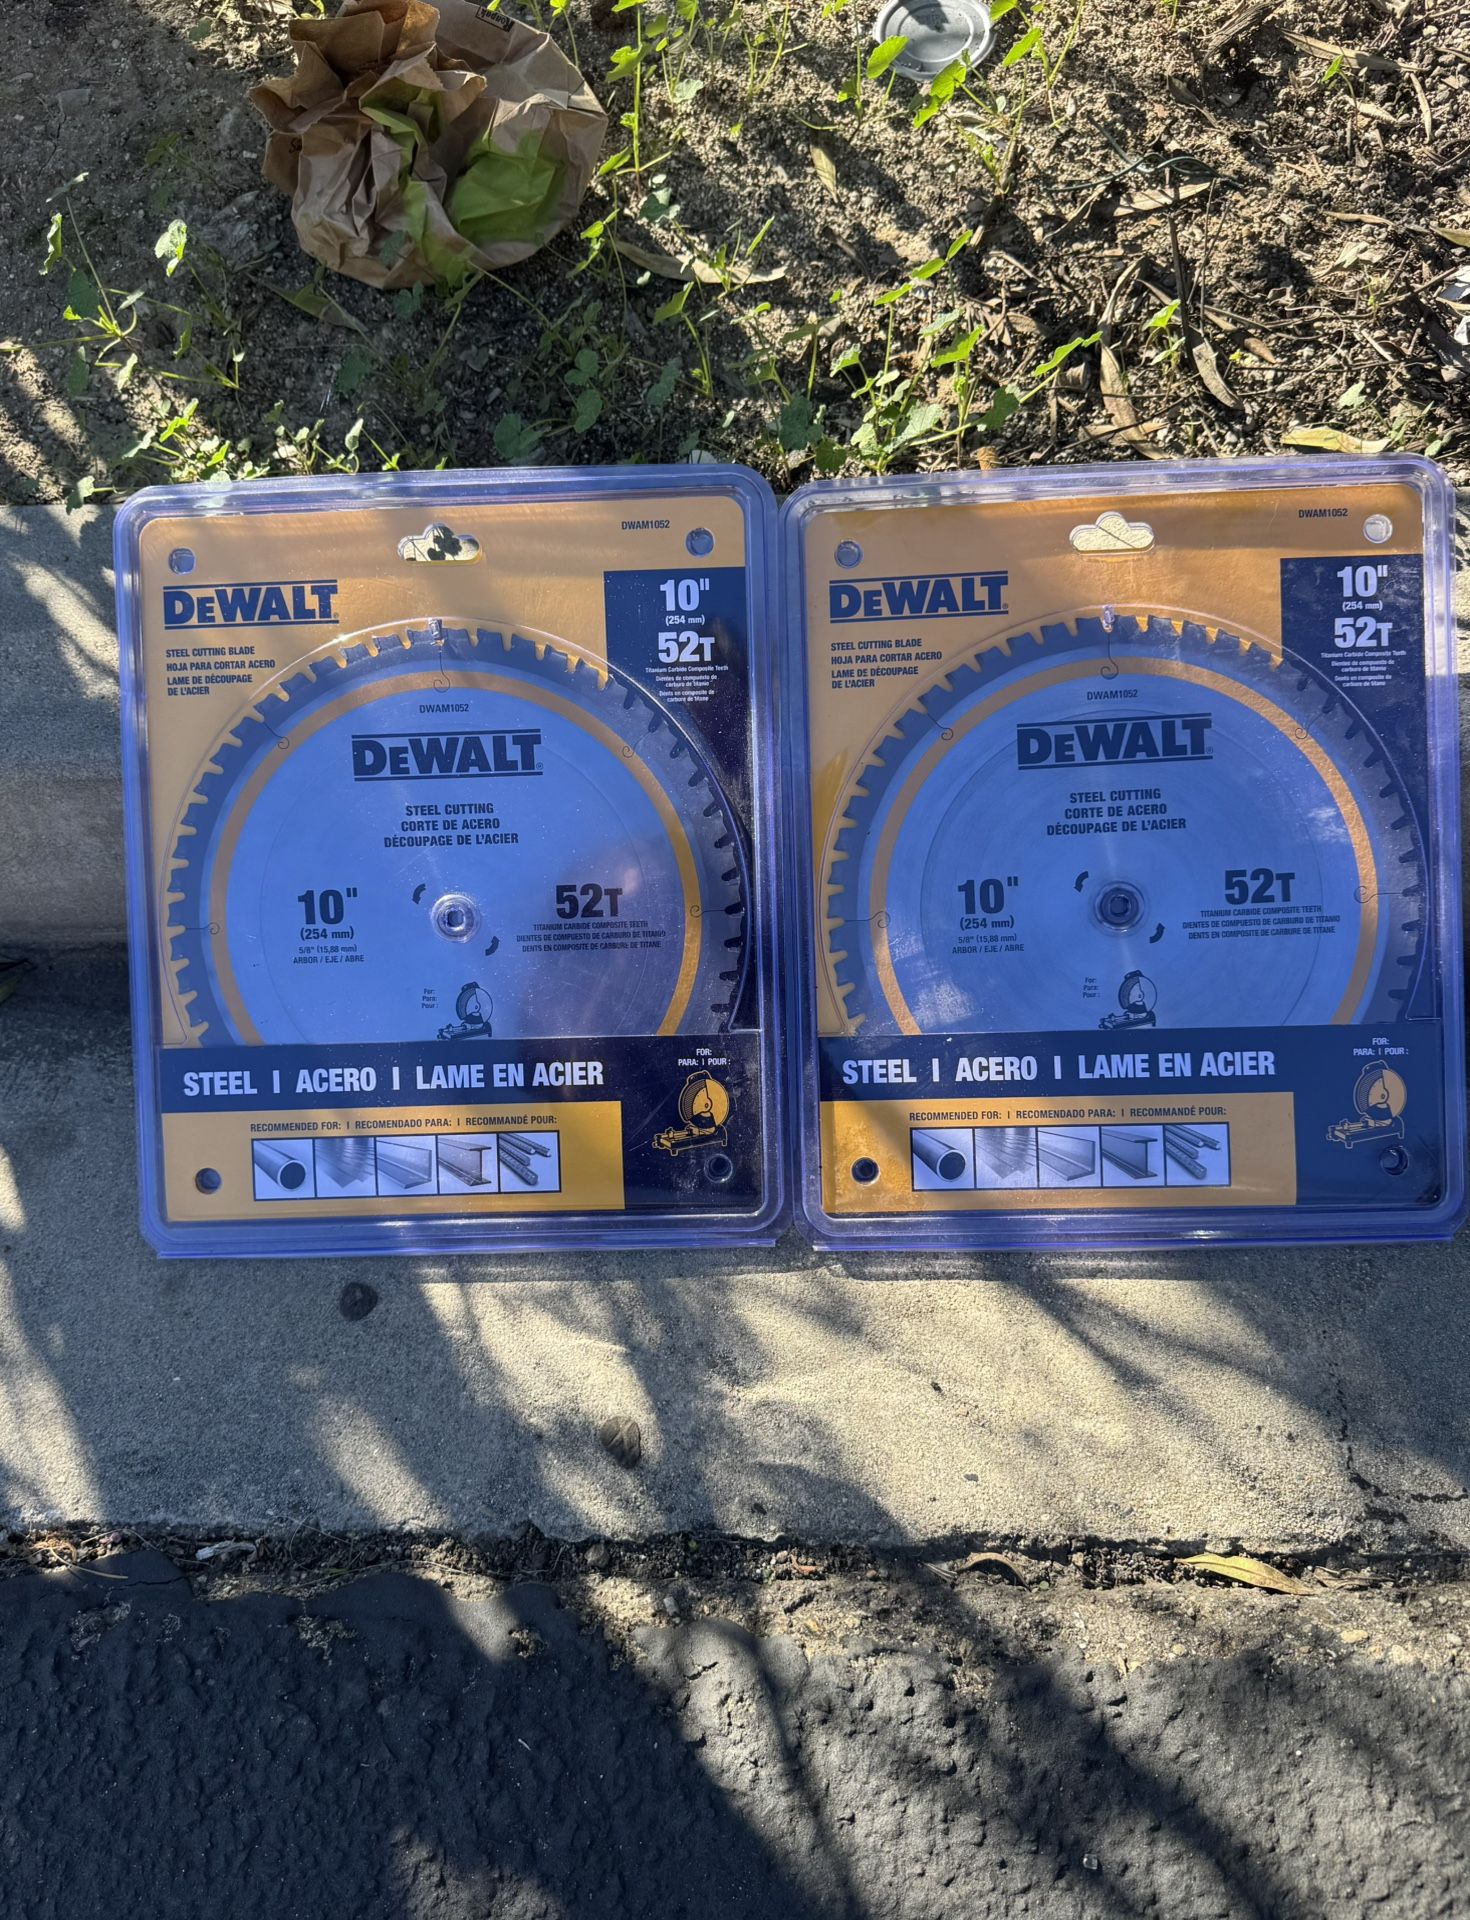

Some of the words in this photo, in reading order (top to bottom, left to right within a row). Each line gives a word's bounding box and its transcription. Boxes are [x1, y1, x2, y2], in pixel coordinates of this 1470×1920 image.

[1299, 508, 1348, 518] DWAM1052
[621, 520, 670, 530] DWAM1052
[1337, 565, 1388, 597] 10"
[660, 578, 710, 611] 10"
[829, 575, 1008, 619] DEWALT
[163, 584, 338, 625] DEWALT
[1342, 601, 1363, 611] (254
[1365, 601, 1383, 610] mm)
[665, 615, 686, 626] (254
[688, 614, 705, 625] mm)
[1334, 616, 1392, 648] 52T
[166, 648, 190, 658] STEEL
[192, 646, 226, 657] CUTTING
[228, 645, 255, 656] BLADE
[658, 630, 715, 663] 52T
[831, 642, 856, 651] STEEL
[858, 640, 893, 650] CUTTING
[895, 639, 922, 648] BLADE
[831, 655, 853, 665] HOJA
[855, 654, 877, 664] PARA
[880, 653, 914, 662] CORTAR
[915, 651, 942, 661] ACERO
[166, 662, 188, 672] HOJA
[189, 661, 211, 671] PARA
[212, 659, 246, 670] CORTAR
[248, 659, 275, 668] ACERO
[832, 669, 854, 678] LAME
[857, 668, 868, 677] DE
[870, 665, 919, 677] DÉCOUPAGE
[167, 676, 190, 686] LAME
[192, 676, 203, 685] DE
[205, 673, 253, 684] DÉCOUPAGE
[832, 680, 843, 689] DE
[844, 679, 875, 688] L'ACIER
[168, 687, 179, 696] DE
[180, 685, 210, 696] L'ACIER
[1087, 689, 1138, 700] DWAM1052
[419, 703, 469, 714] DWAM1052
[1017, 718, 1212, 765] DEWALT
[352, 734, 541, 776] DEWALT
[1070, 792, 1106, 804] STEEL
[1110, 788, 1161, 801] CUTTING
[405, 805, 441, 816] STEEL
[444, 803, 494, 815] CUTTING
[1064, 808, 1103, 819] CORTE
[1108, 806, 1123, 817] DE
[1127, 803, 1167, 816] ACERO
[401, 820, 438, 832] CORTE
[443, 819, 457, 831] DE
[462, 818, 500, 830] ACERO
[1047, 822, 1118, 836] DÉCOUPAGE
[1122, 821, 1137, 832] DE
[1141, 818, 1186, 831] L'ACIER
[384, 835, 453, 848] DÉCOUPAGE
[457, 835, 471, 845] DE
[476, 833, 519, 845] L'ACIER
[1224, 868, 1295, 905] 52T
[556, 883, 623, 919] 52T
[958, 876, 1018, 915] 10"
[297, 887, 358, 925] 10"
[1200, 910, 1231, 918] TITANIUM
[1233, 908, 1261, 916] CARBIDE
[1262, 906, 1301, 915] COMPOSITE
[1302, 905, 1322, 913] TEETH
[564, 922, 591, 930] CARBIDE
[960, 917, 987, 931] (254
[991, 915, 1015, 929] mm)
[1182, 921, 1210, 929] DIENTES
[1221, 919, 1261, 927] COMPUESTO
[1262, 918, 1271, 926] DE
[1273, 917, 1304, 925] CARBURO
[1315, 915, 1341, 923] TITANIO
[300, 928, 328, 941] (254
[331, 926, 355, 940] mm)
[553, 933, 591, 941] COMPUESTO
[601, 931, 631, 939] CARBURO
[976, 935, 999, 943] (15,88
[1000, 934, 1017, 942] mm)
[1188, 932, 1210, 940] DENTS
[1211, 931, 1220, 939] EN
[1222, 929, 1260, 938] COMPOSITE
[1260, 929, 1270, 937] DE
[1271, 928, 1301, 936] CARBURE
[1302, 927, 1312, 935] DE
[1313, 926, 1336, 934] TITANE
[340, 944, 357, 953] mm)
[553, 943, 589, 951] COMPOSITE
[952, 946, 977, 954] ARBOR
[984, 945, 998, 953] EJE
[1004, 944, 1024, 952] ABRE
[293, 956, 318, 964] ARBOR
[1353, 1047, 1376, 1056] PARA:
[678, 1058, 699, 1066] PARA:
[842, 1058, 917, 1085] STEEL
[955, 1055, 1037, 1082] ACERO
[1078, 1054, 1150, 1079] LAME
[1158, 1052, 1192, 1077] EN
[1200, 1050, 1276, 1076] ACIER
[183, 1071, 257, 1096] STEEL
[296, 1067, 377, 1093] ACERO
[416, 1064, 485, 1090] LAME
[493, 1063, 524, 1087] EN
[532, 1061, 604, 1086] ACIER
[909, 1110, 979, 1121] RECOMMENDED
[981, 1110, 1002, 1119] FOR:
[1016, 1108, 1085, 1119] RECOMENDADO
[1087, 1108, 1116, 1117] PARA:
[1130, 1105, 1196, 1117] RECOMMANDÉ
[1198, 1106, 1227, 1116] POUR:
[250, 1122, 318, 1132] RECOMMENDED
[321, 1121, 341, 1130] FOR:
[355, 1119, 422, 1129] RECOMENDADO
[425, 1118, 452, 1127] PARA:
[466, 1115, 529, 1126] RECOMMANDÉ
[530, 1115, 557, 1124] POUR:
